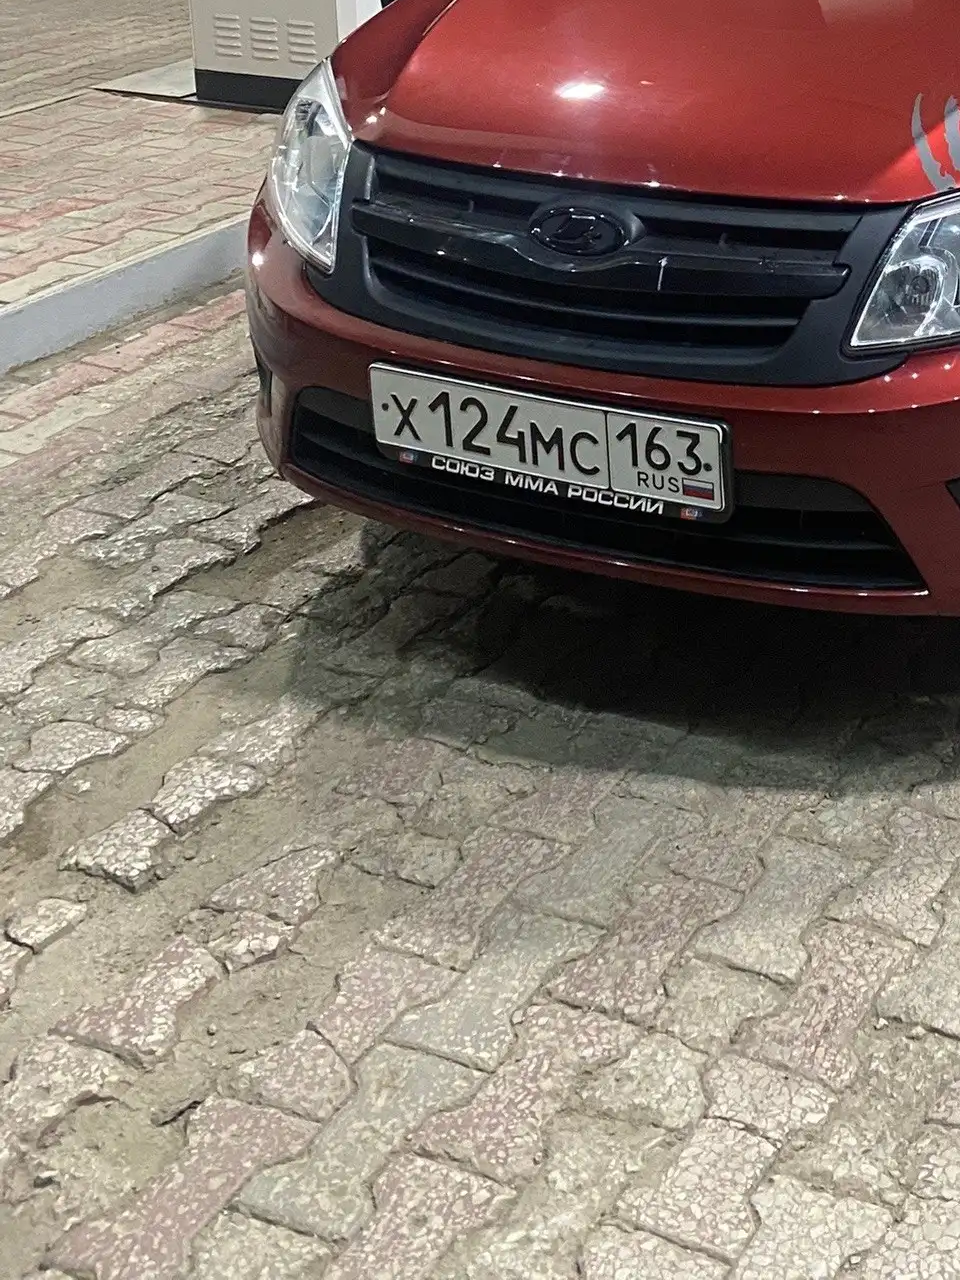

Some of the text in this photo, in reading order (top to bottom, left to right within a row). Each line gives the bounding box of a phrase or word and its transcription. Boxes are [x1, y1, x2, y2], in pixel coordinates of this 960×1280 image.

[390, 391, 703, 477] Х124МС 163
[430, 455, 665, 516] СОЮЗ ММА РОССИИ
[637, 470, 681, 494] RUS
